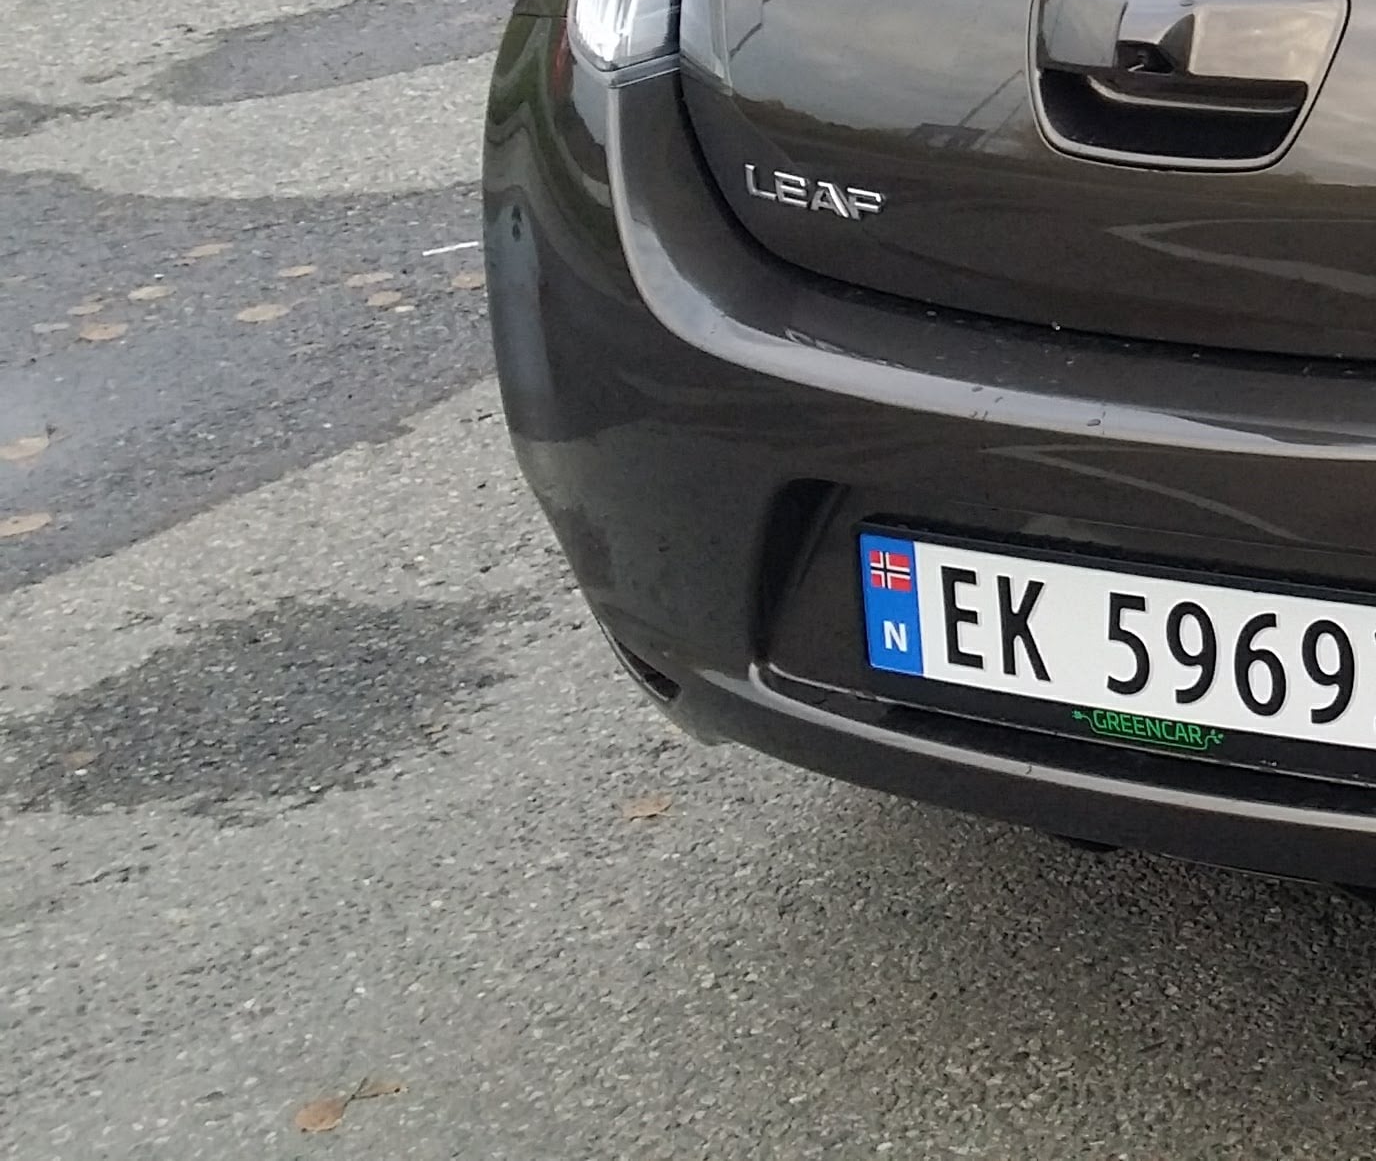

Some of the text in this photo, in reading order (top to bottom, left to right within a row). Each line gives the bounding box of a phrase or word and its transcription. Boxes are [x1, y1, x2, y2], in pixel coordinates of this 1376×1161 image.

[743, 162, 887, 221] LEAF
[883, 619, 908, 653] N
[940, 564, 1052, 683] EK
[1092, 709, 1204, 745] GREENCAR
